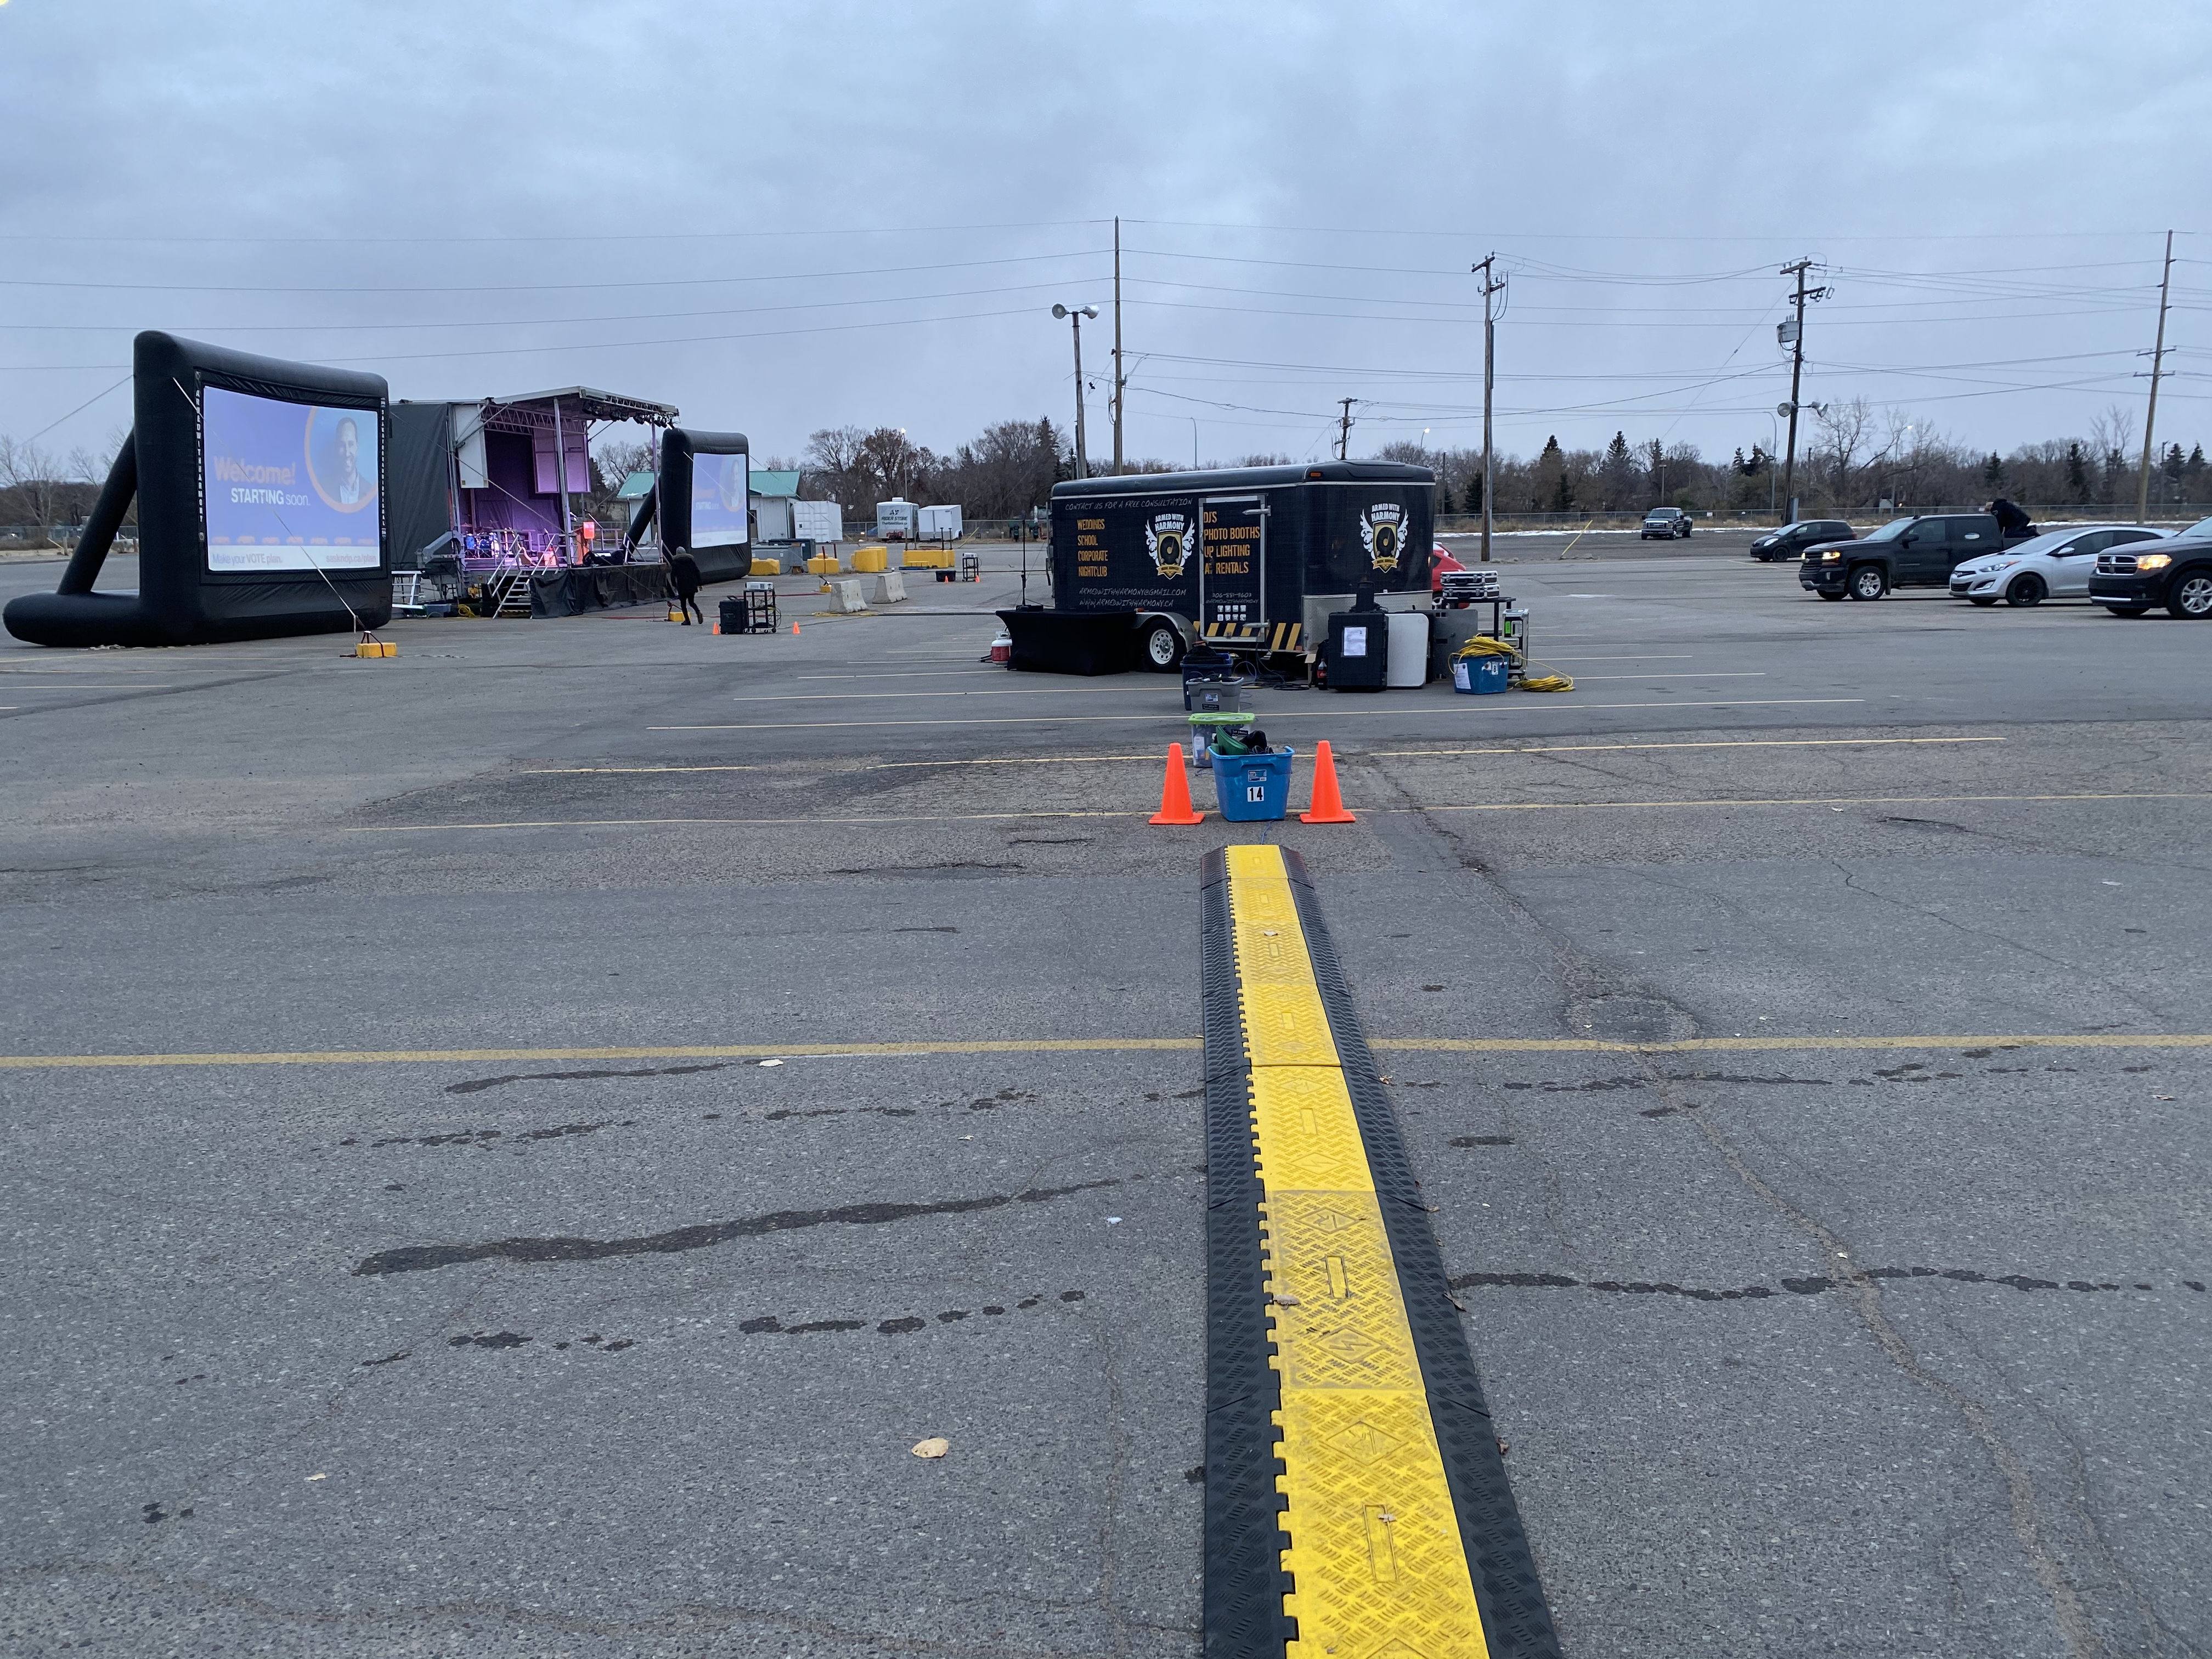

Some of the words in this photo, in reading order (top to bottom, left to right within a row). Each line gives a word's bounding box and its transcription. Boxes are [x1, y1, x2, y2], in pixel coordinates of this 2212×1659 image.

[213, 455, 296, 485] Welcome!
[231, 488, 284, 505] STARTING
[1065, 502, 1094, 510] CONTACT
[1104, 501, 1116, 509] FOR
[1119, 500, 1124, 509] A
[1125, 500, 1140, 508] FREE
[1141, 498, 1193, 507] CONSULTATION
[1372, 503, 1389, 512] ARMED
[1389, 503, 1400, 512] WITH
[1155, 514, 1171, 522] ARMED
[1172, 514, 1184, 522] WITH
[1371, 511, 1400, 522] HARMONY
[1077, 518, 1105, 530] WEDDINGS
[1154, 521, 1184, 532] HARMONY
[1204, 528, 1228, 540] PHOTO
[1229, 527, 1260, 539] BOOTHS
[1077, 534, 1098, 546] SCHOOL
[1077, 550, 1108, 562] CORPORATE
[1204, 545, 1214, 557] UP
[1216, 544, 1250, 557] LIGHTING
[212, 553, 230, 563] Make
[231, 556, 245, 566] your
[246, 553, 266, 563] VOTE
[1078, 566, 1107, 577] NIGHTCLUB
[1216, 561, 1249, 574] RENTALS
[1250, 787, 1263, 801] 14
